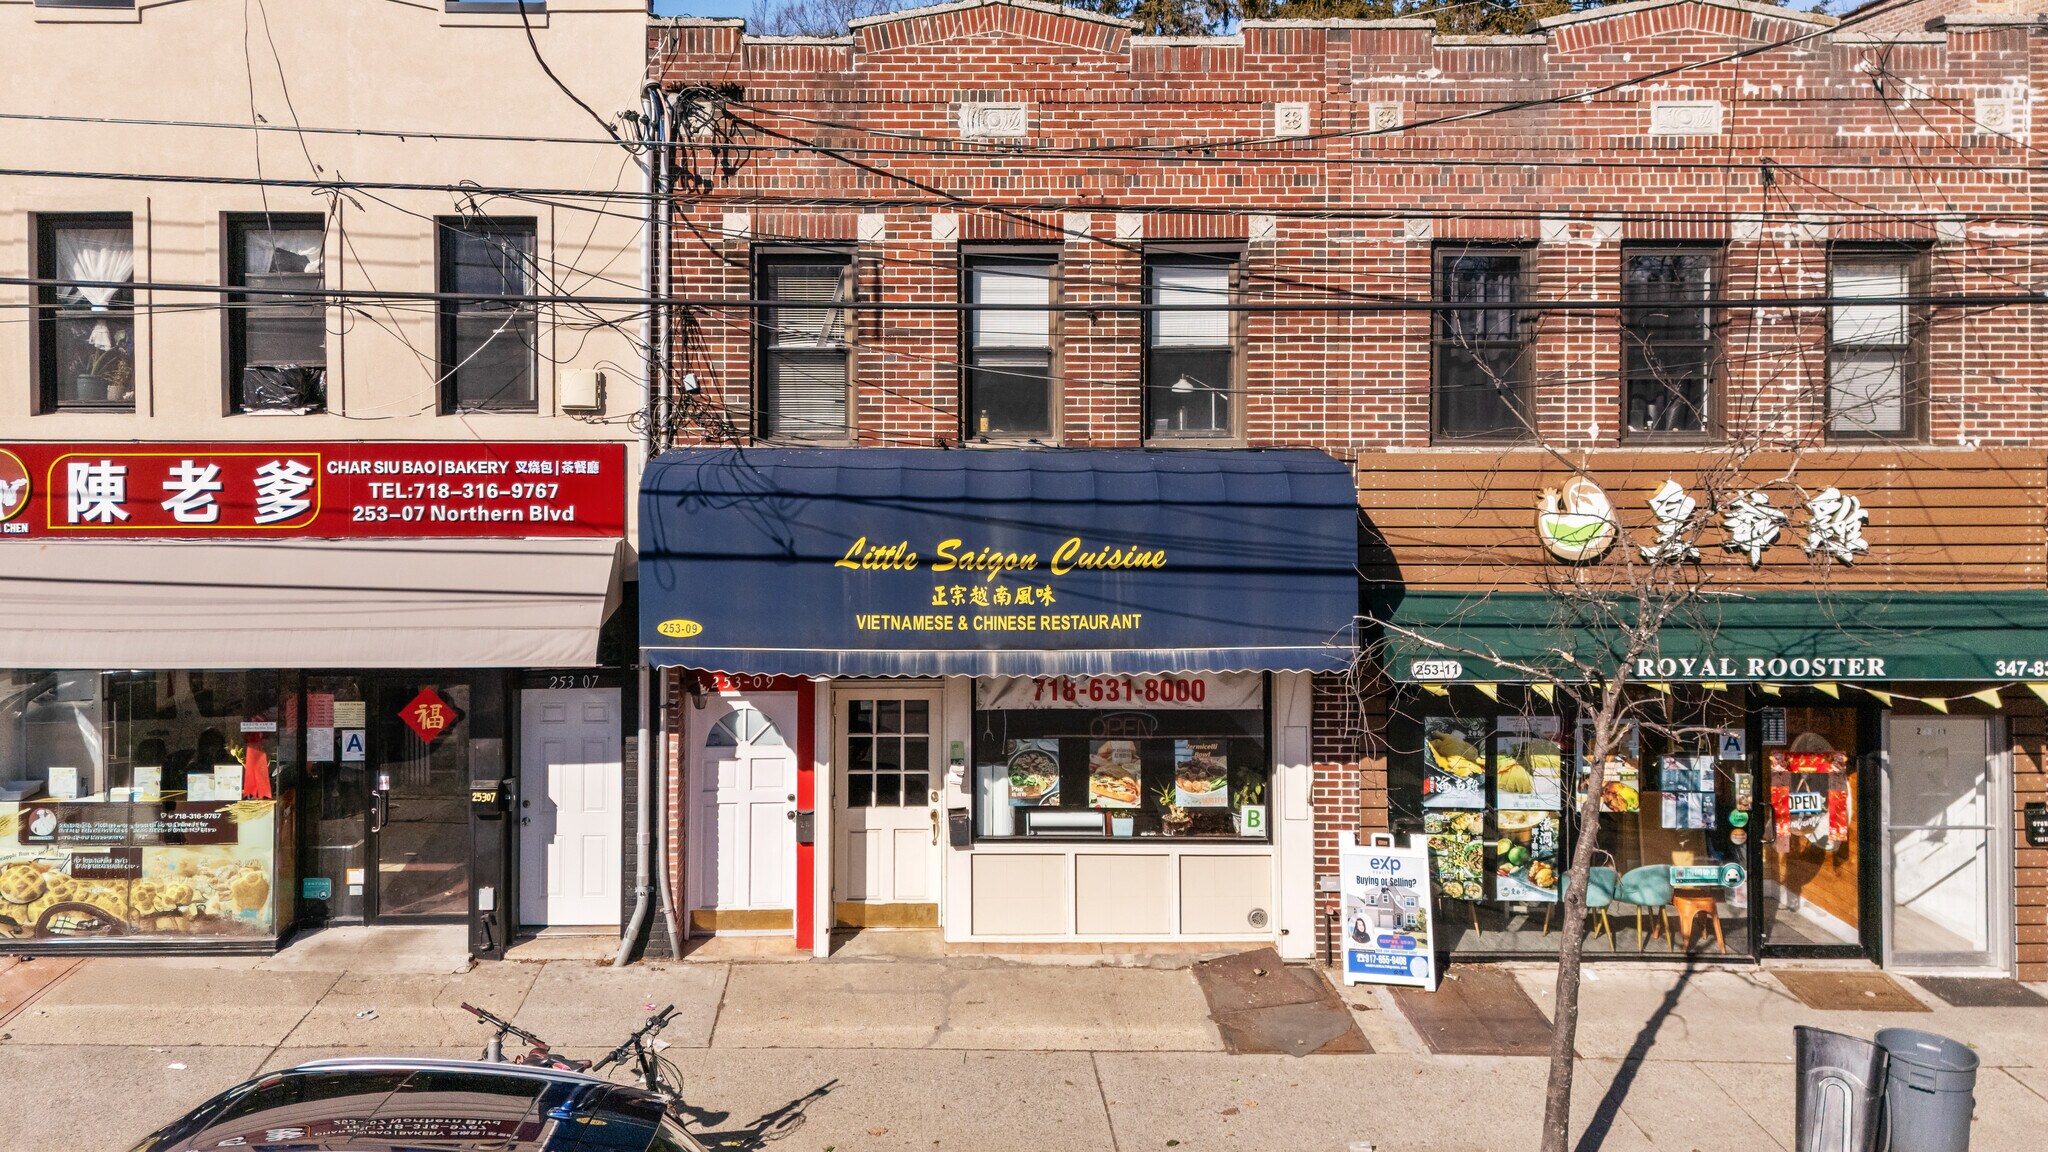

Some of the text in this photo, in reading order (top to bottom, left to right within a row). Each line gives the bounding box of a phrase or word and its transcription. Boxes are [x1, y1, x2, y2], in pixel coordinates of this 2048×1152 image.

[327, 461, 371, 475] CHAR
[374, 461, 400, 475] SIU
[67, 460, 315, 525] 陳老爹
[368, 482, 560, 500] TEL:718-316-9767
[352, 505, 575, 522] 253-07 Northern Blvd
[4, 523, 29, 534] CHEN
[834, 536, 1168, 582] Little Saigon Cuisine
[931, 585, 1056, 607] 正宗越南風味
[662, 623, 699, 634] 253-09
[856, 613, 1142, 630] VIETNAMESE & CHINESE RESTAURANT
[1415, 664, 1458, 676] 253-11
[1637, 657, 1887, 677] ROYAL ROOSTER
[549, 675, 600, 689] 253 07
[710, 675, 774, 689] 253-09
[1033, 678, 1206, 703] 718-631-8000
[414, 703, 444, 730] 福
[346, 733, 363, 752] A
[1723, 735, 1742, 752] A
[471, 792, 497, 803] 25307
[174, 812, 222, 820] 718-316-9767
[1247, 809, 1261, 828] B
[1356, 875, 1417, 888] Buying or Selling?
